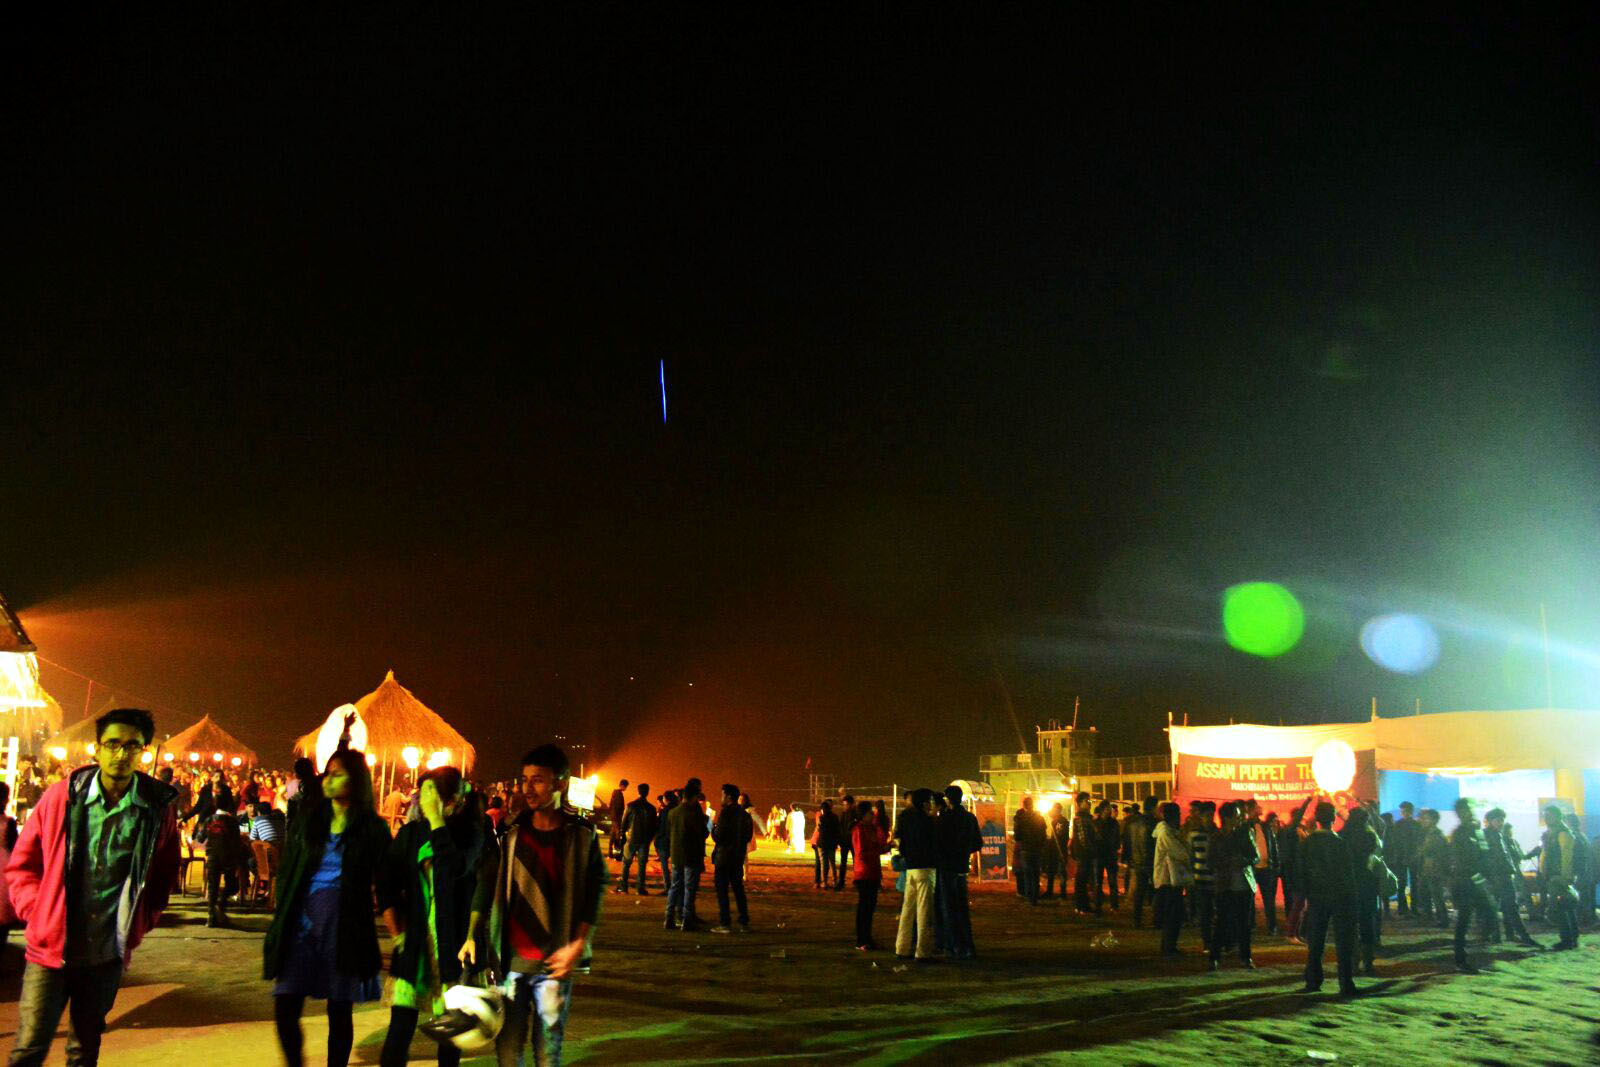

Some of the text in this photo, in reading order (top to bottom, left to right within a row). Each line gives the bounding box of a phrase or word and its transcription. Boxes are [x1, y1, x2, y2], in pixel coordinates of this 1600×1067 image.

[1196, 762, 1314, 781] ASSAM PUPPET TH
